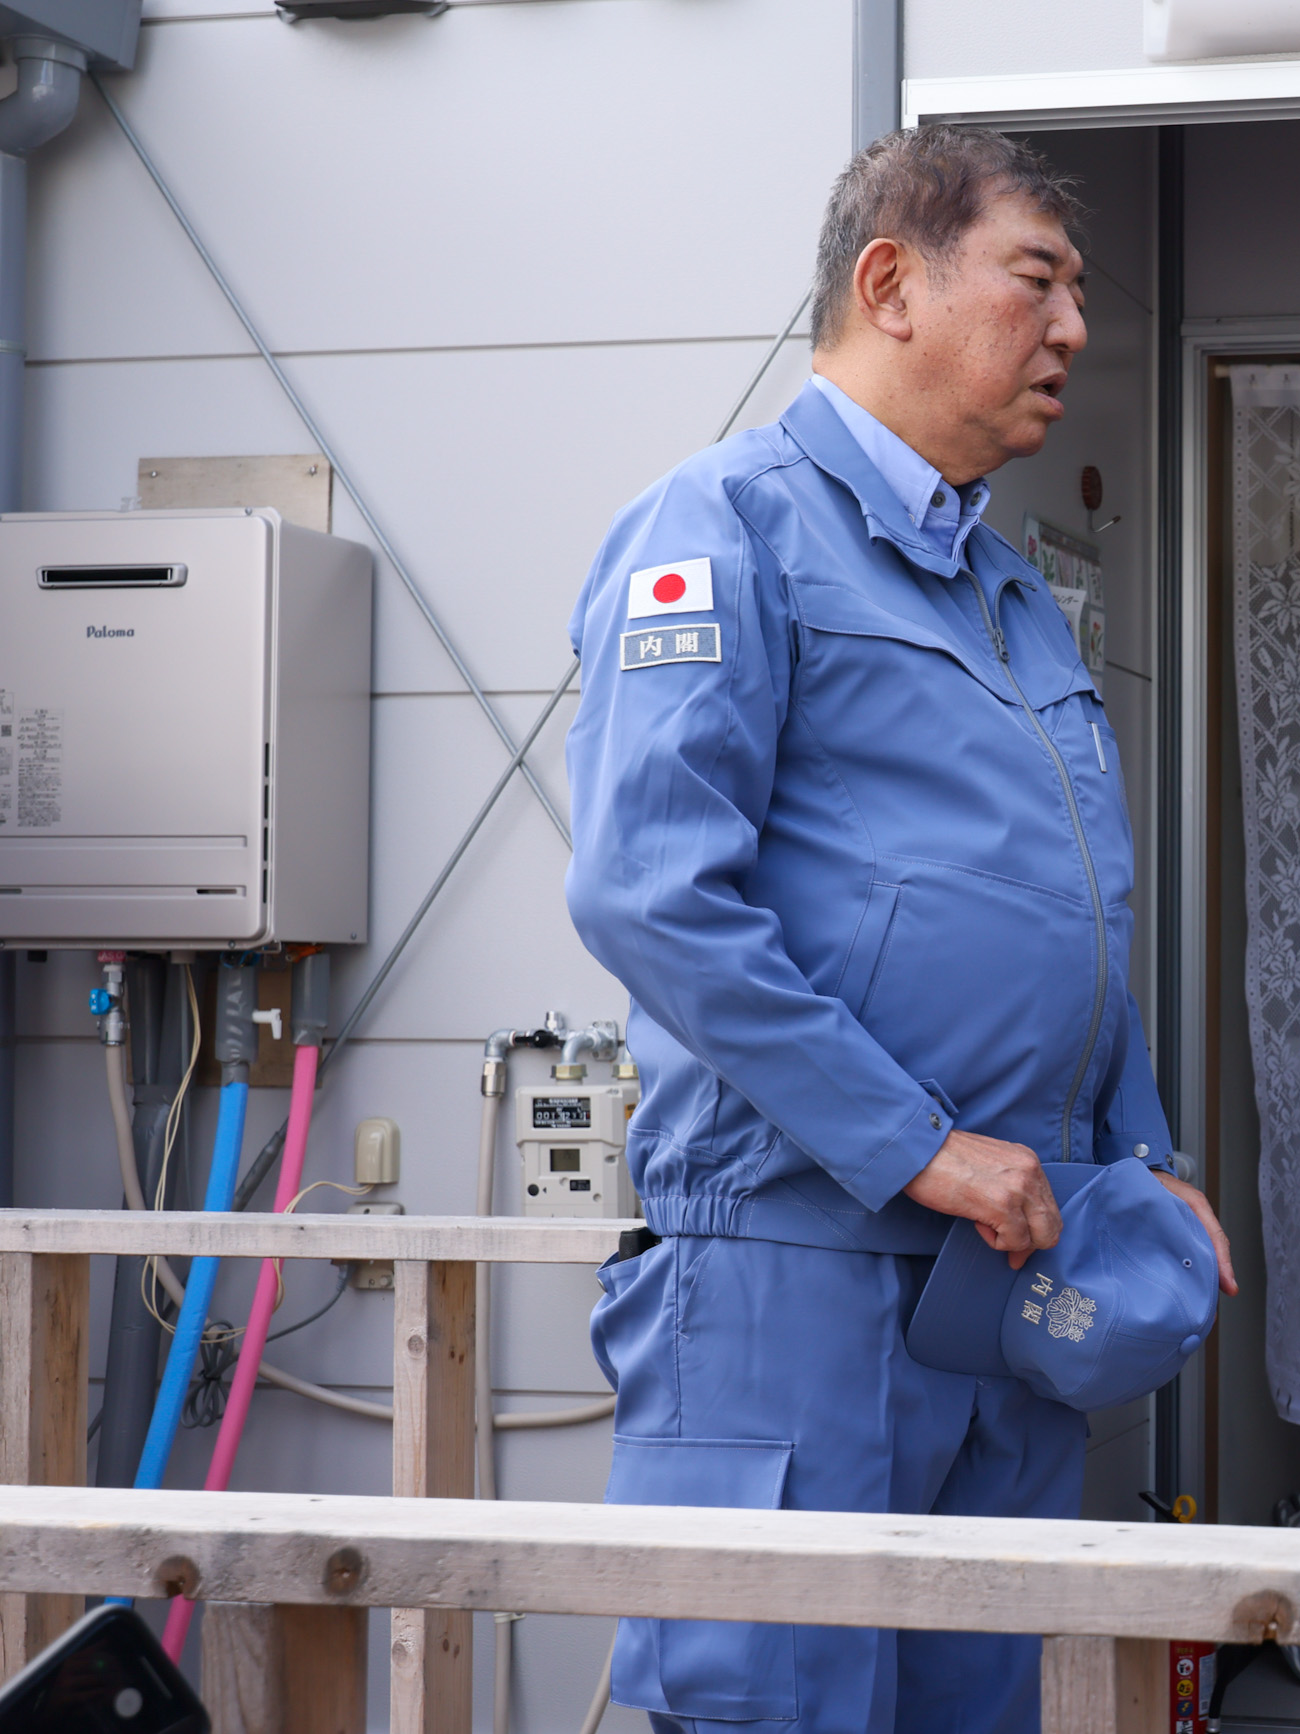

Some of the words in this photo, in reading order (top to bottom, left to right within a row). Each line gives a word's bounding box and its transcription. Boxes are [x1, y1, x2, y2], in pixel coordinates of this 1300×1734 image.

[86, 625, 134, 638] Paloma
[640, 632, 698, 659] 内閣
[1021, 1273, 1053, 1325] 内閣
